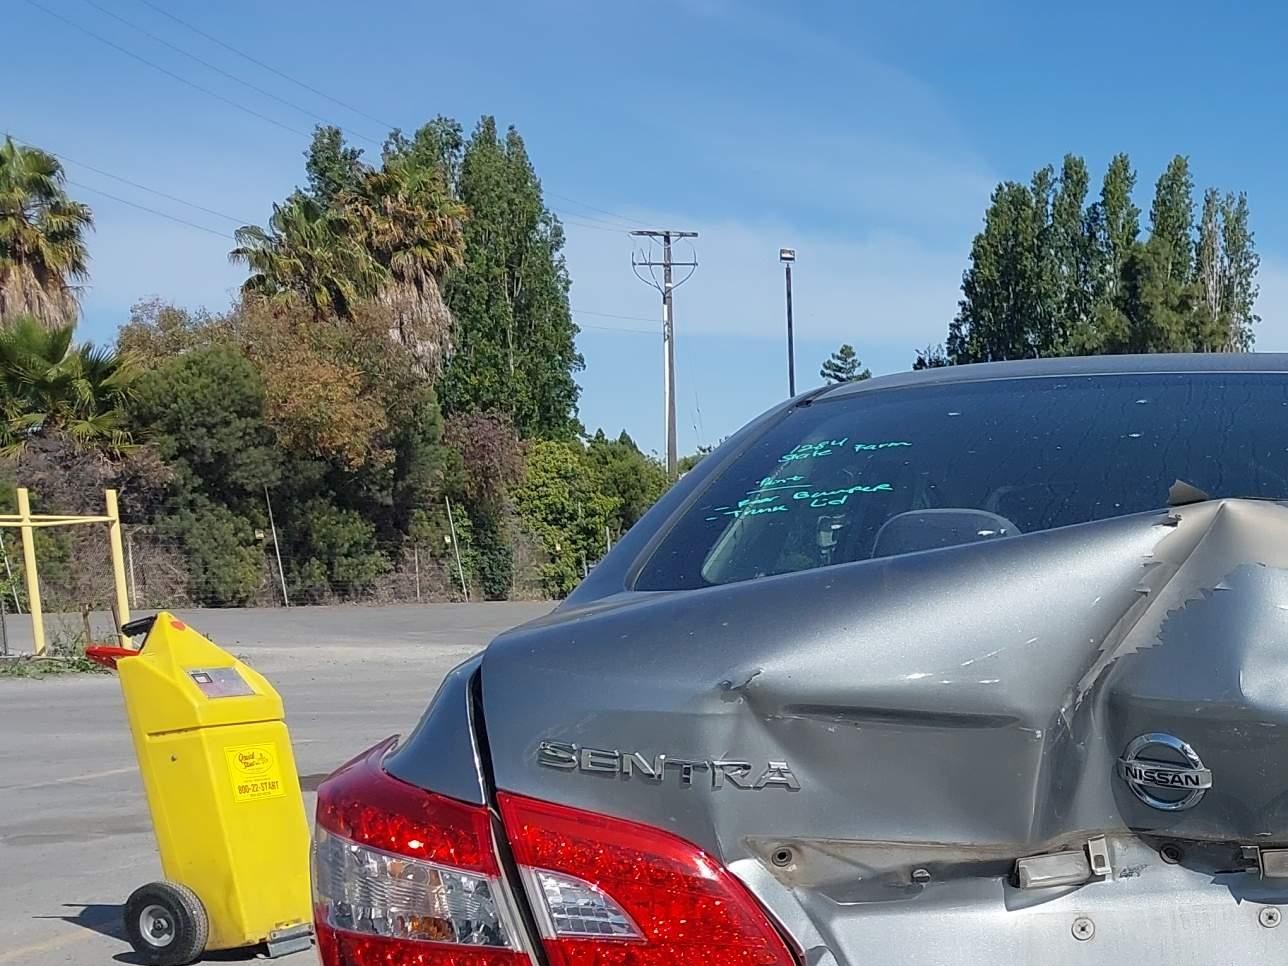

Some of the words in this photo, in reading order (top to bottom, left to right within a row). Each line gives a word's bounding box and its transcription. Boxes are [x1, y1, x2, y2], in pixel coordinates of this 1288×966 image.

[536, 740, 801, 792] SENTRA
[1125, 765, 1200, 786] NISSAN
[237, 780, 279, 795] 800-22-START
